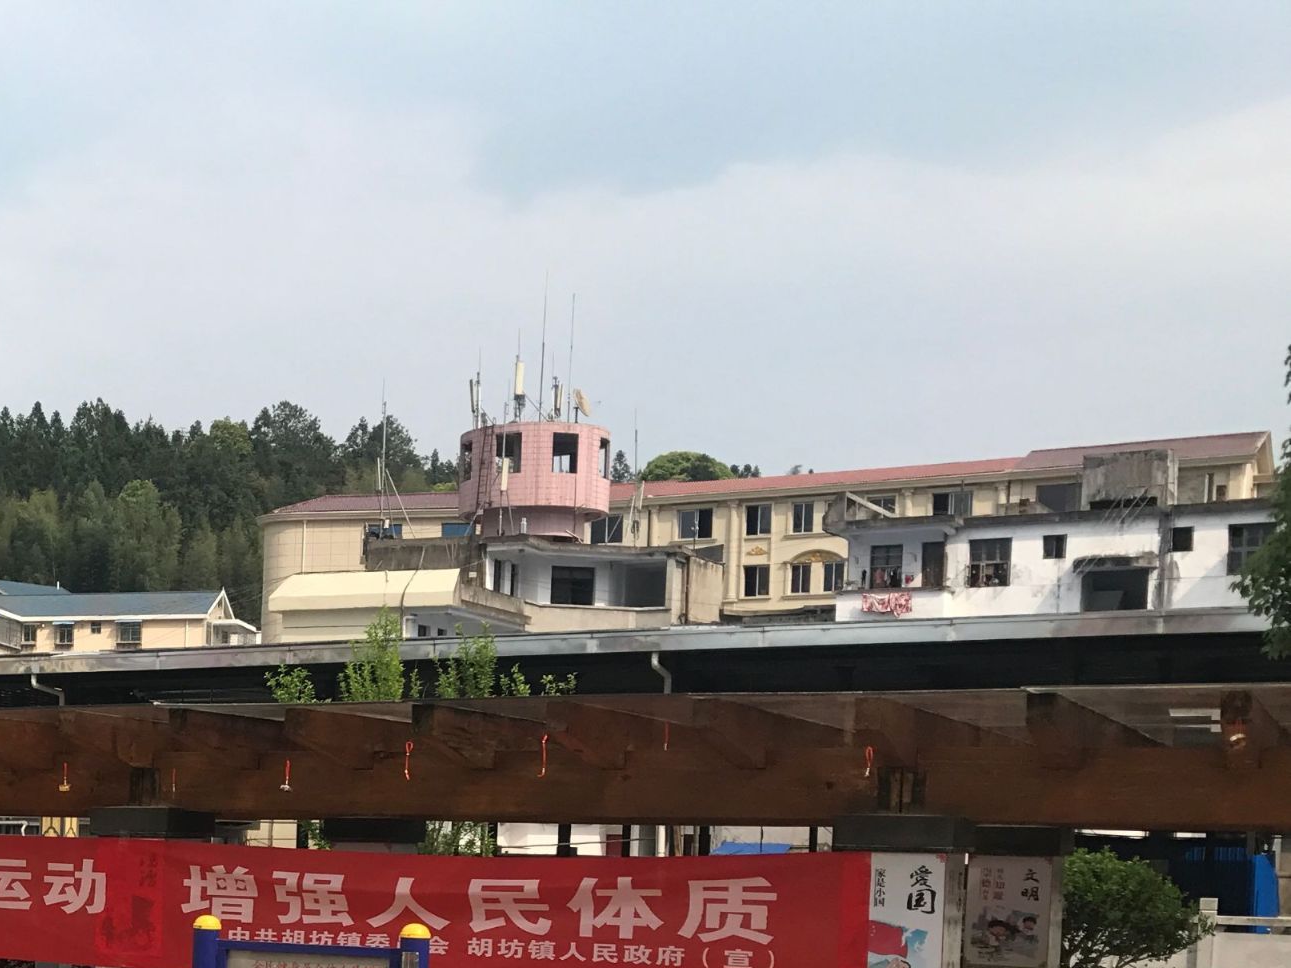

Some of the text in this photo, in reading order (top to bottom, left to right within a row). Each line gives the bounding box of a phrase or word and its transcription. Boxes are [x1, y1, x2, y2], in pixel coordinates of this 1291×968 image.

[1021, 868, 1040, 901] 文明
[180, 865, 778, 946] 增强人民体质
[228, 926, 450, 955] 中共胡坊镇委会
